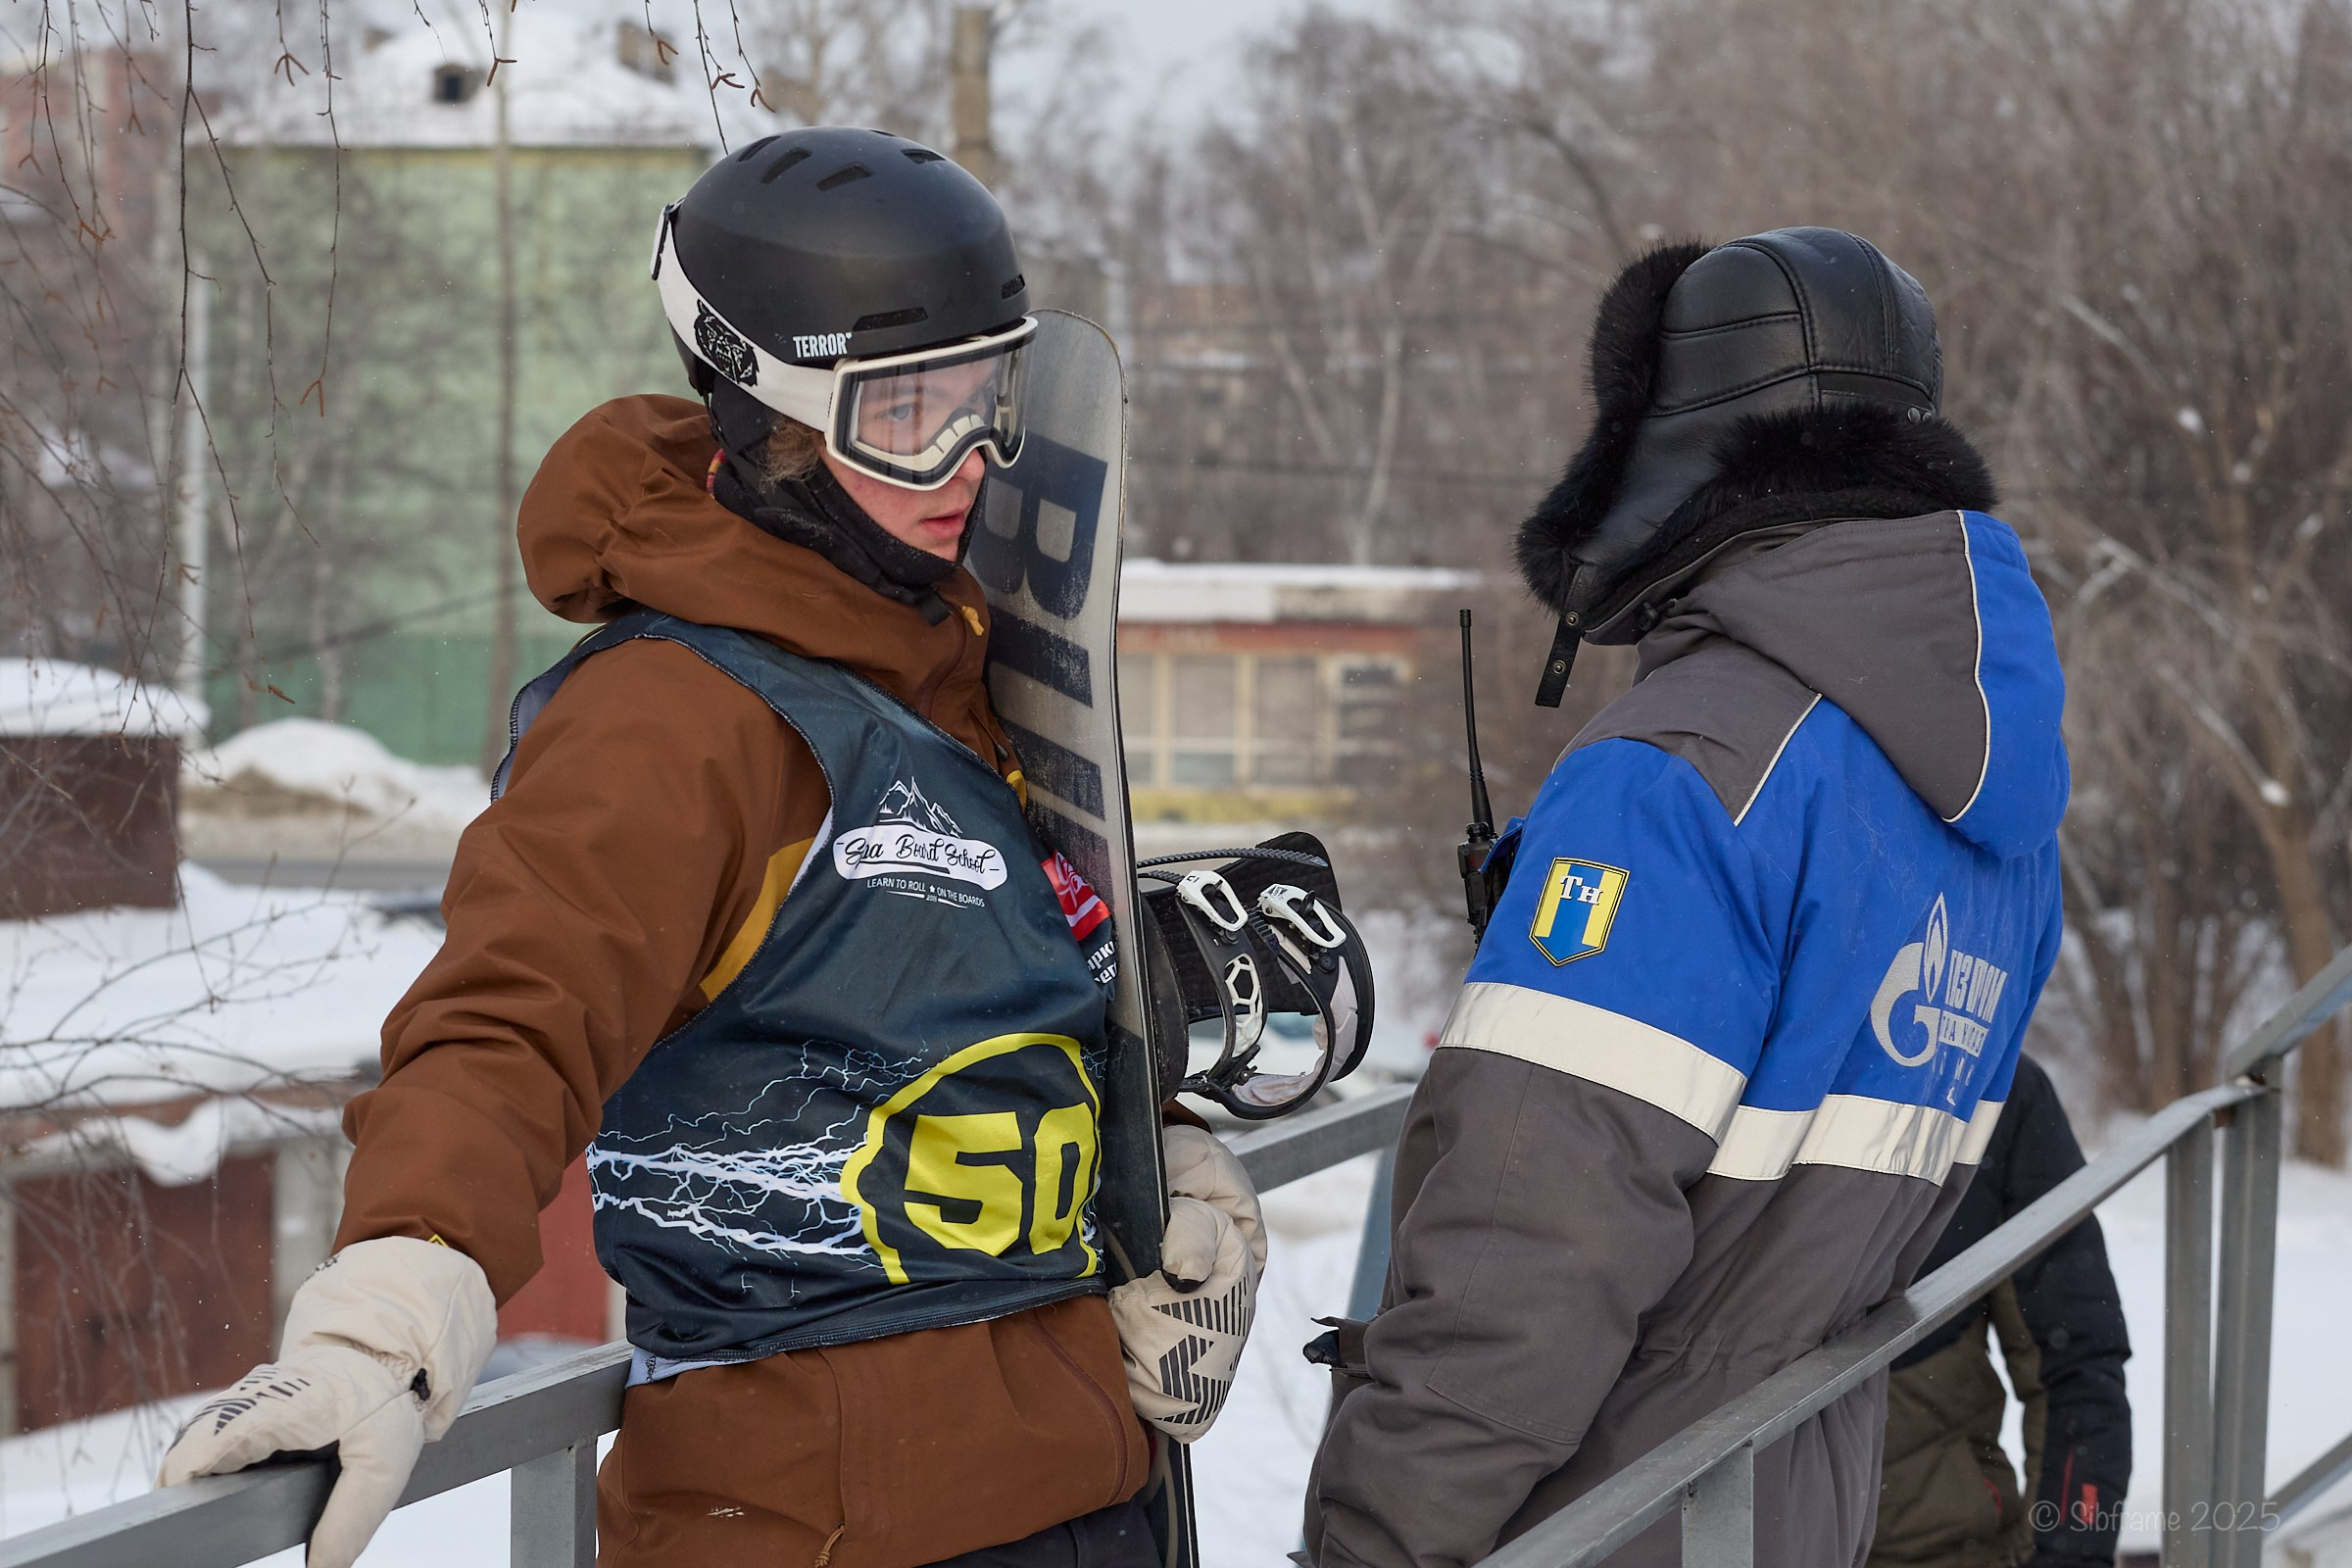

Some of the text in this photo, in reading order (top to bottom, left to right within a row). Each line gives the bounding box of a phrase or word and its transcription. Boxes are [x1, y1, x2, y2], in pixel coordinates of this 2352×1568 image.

[792, 332, 849, 359] TERROR
[944, 843, 996, 874] School
[866, 877, 986, 907] LEARN TO ROLL ON THE BOARDS
[903, 1102, 1097, 1258] 50
